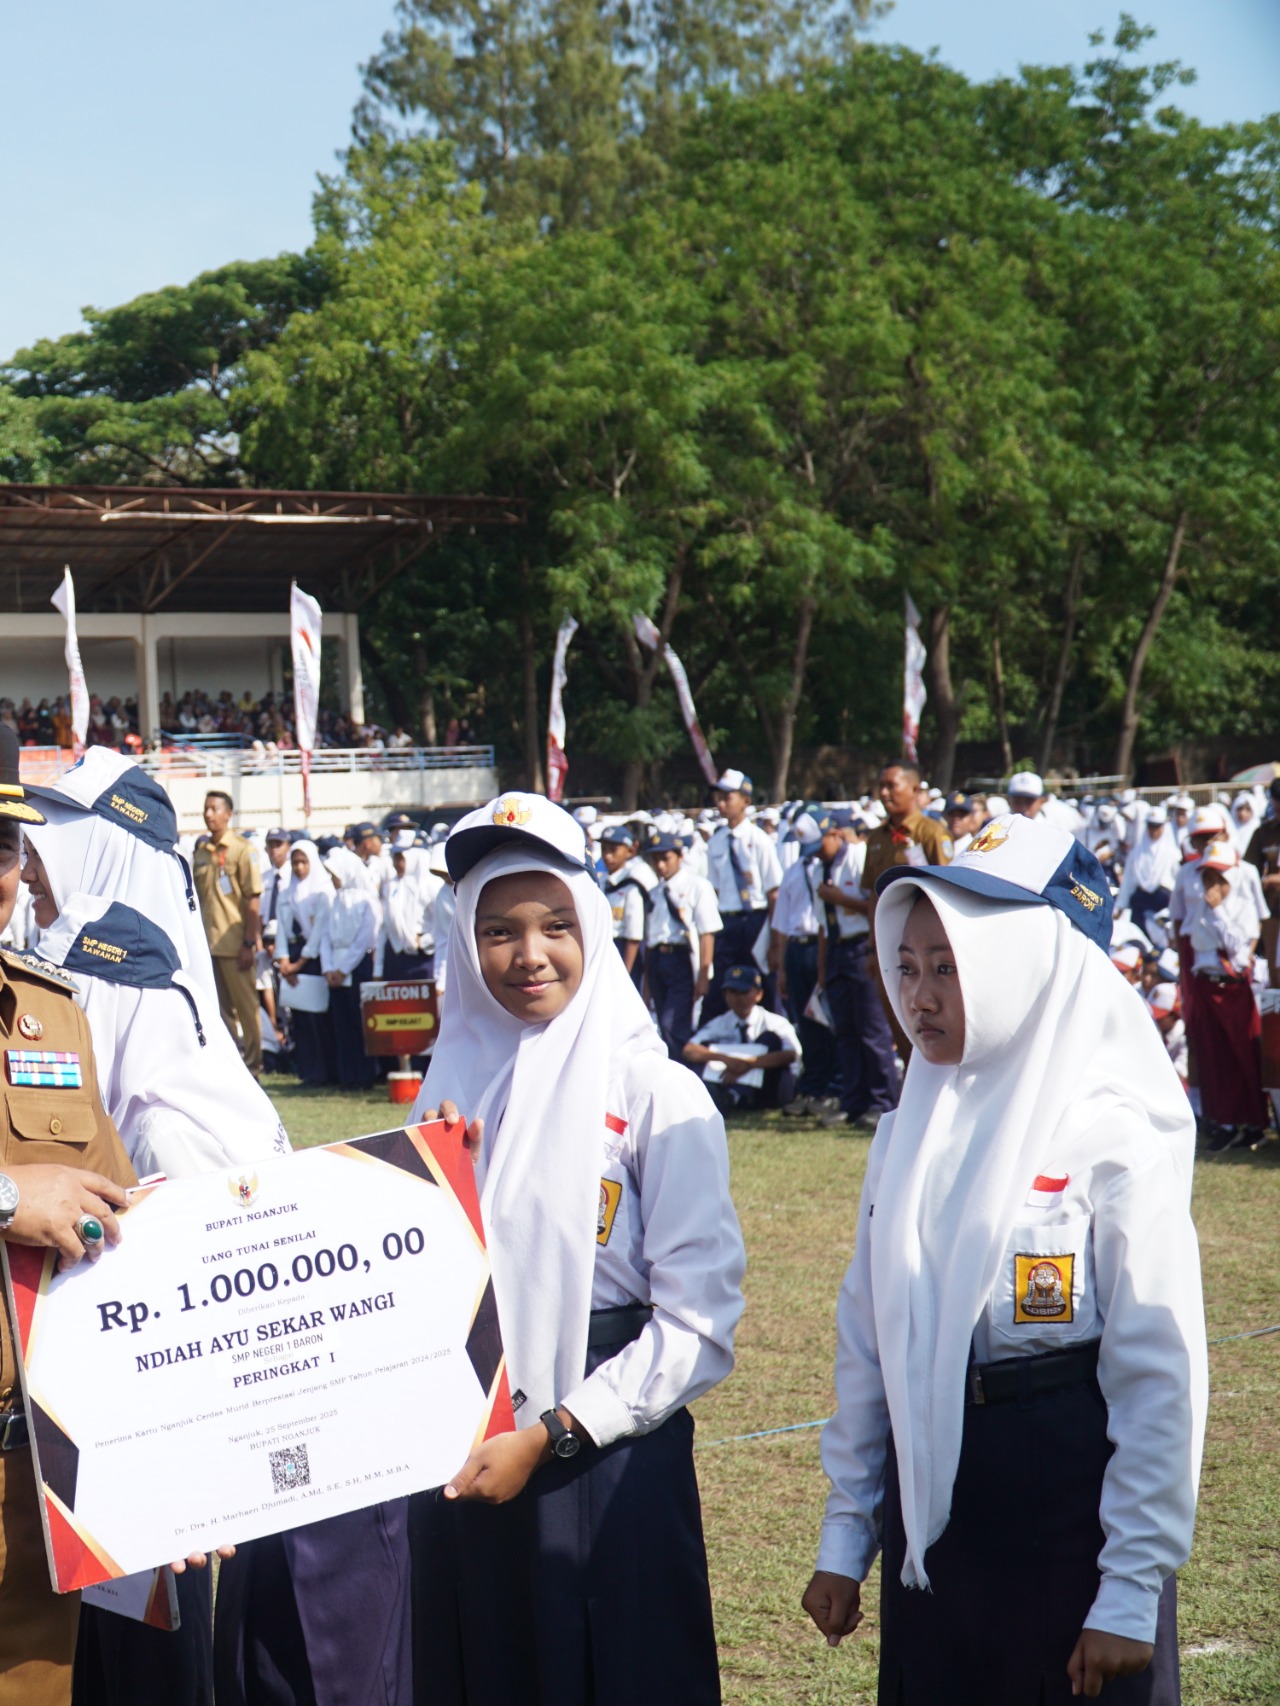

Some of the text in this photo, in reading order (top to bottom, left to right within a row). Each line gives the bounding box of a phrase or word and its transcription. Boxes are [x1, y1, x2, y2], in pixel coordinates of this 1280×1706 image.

[110, 801, 144, 824] SAWAHAN
[1070, 886, 1095, 911] BARON
[82, 936, 98, 947] SMP
[97, 942, 123, 956] NEGERI
[82, 944, 122, 963] SAWAHAN
[205, 1203, 299, 1232] BUPATI NGANJUK
[201, 1230, 316, 1264] UANG TUNAI SENILAI
[96, 1227, 426, 1334] Rp. 1.000.000, 00
[237, 1301, 275, 1316] Diberikan
[135, 1292, 396, 1373] NDIAH AYU SEKAR WANGI
[231, 1352, 250, 1364] SMP
[253, 1342, 284, 1359] NEGERI
[293, 1333, 324, 1349] BARON
[232, 1356, 321, 1388] PERINGKAT
[95, 1434, 132, 1449] Penerima
[135, 1427, 158, 1439] Kartu
[160, 1417, 194, 1432] Nganjuk
[196, 1410, 223, 1422] Cerdas
[226, 1402, 249, 1414] Murid
[298, 1382, 328, 1395] Jenjang
[329, 1377, 347, 1387] SMP
[349, 1370, 373, 1382] Tahun
[375, 1360, 409, 1375] Pelajaran
[411, 1348, 452, 1365] 2024/2025
[228, 1409, 339, 1444] Nganjuk, 25 September 2025
[249, 1426, 321, 1451] BUPATI NGANJUK
[174, 1527, 188, 1536] Dr.
[222, 1506, 260, 1522] Marhaen
[261, 1495, 299, 1511] Djumadi,
